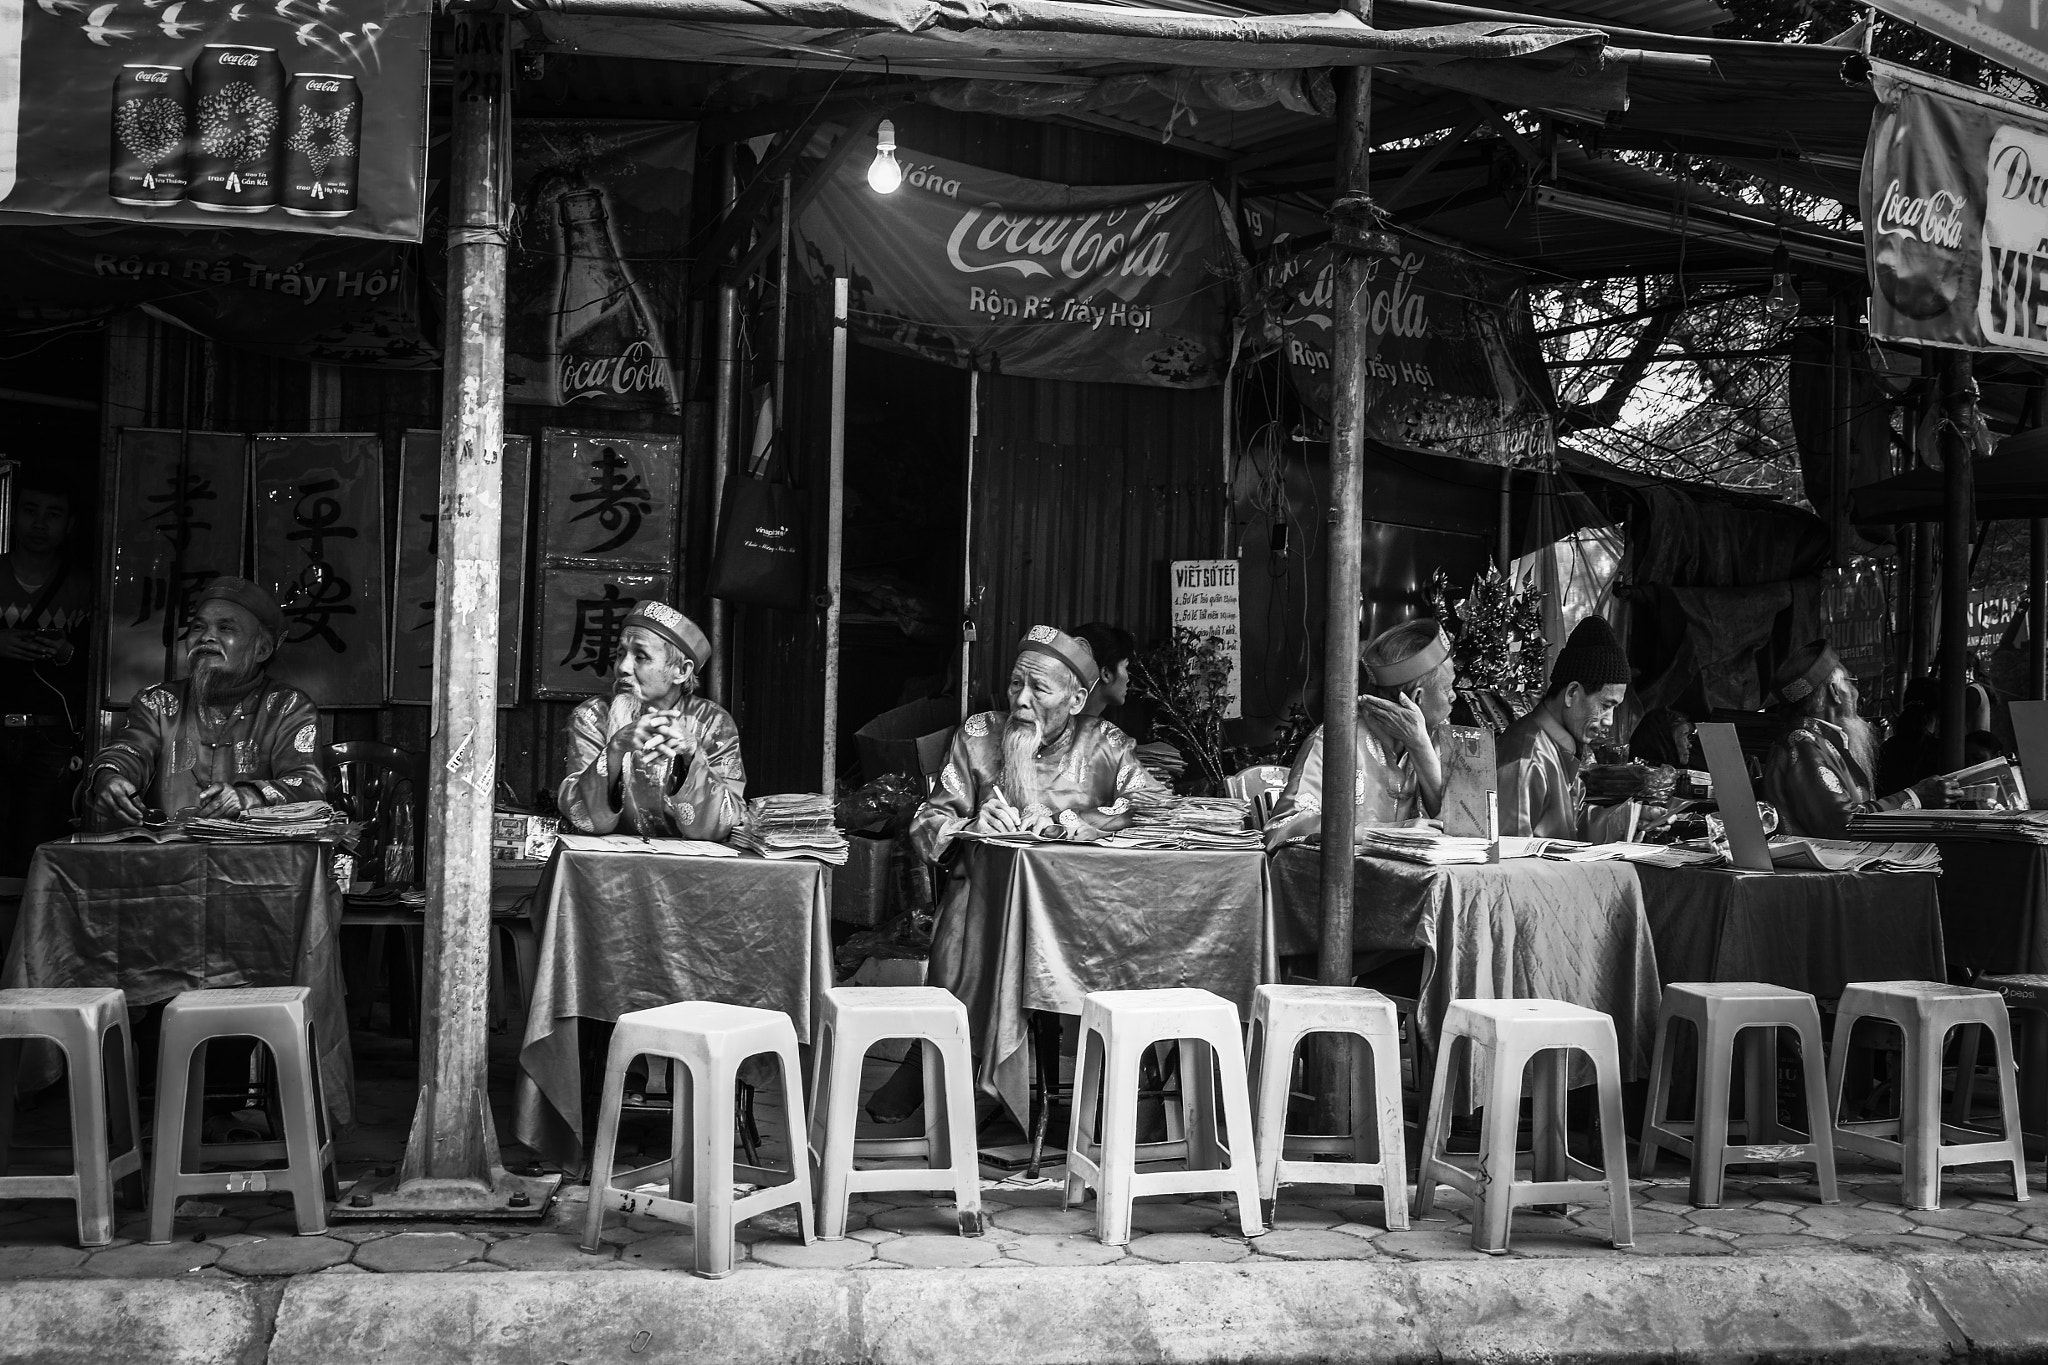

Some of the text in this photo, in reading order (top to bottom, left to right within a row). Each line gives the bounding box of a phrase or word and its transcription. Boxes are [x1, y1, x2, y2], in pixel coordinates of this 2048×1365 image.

[94, 252, 170, 281] Rộn
[182, 257, 234, 285] Rã
[336, 267, 401, 302] Hội
[969, 286, 1018, 321] Rộn
[1109, 301, 1151, 334] Hội
[1291, 340, 1435, 392] Rộn rẩy Hội
